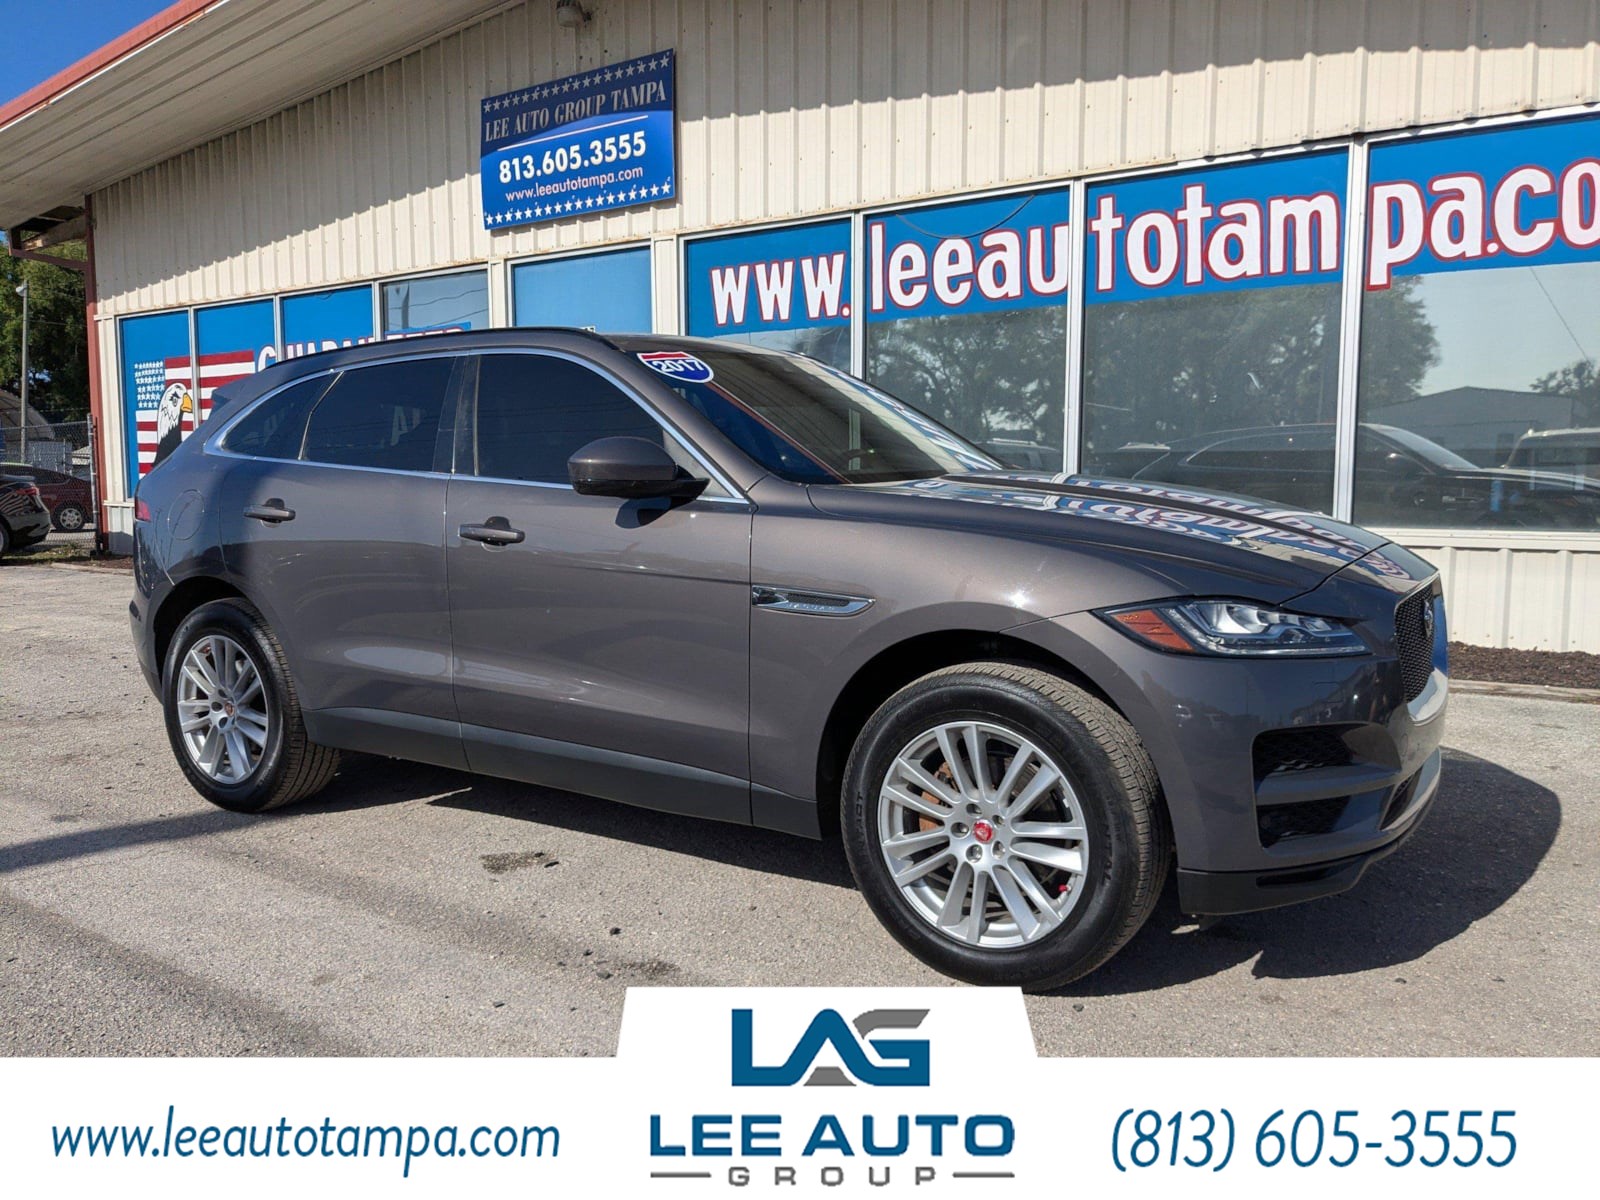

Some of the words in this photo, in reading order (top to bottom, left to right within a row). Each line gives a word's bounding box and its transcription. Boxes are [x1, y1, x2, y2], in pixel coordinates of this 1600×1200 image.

[485, 117, 510, 142] LEE
[513, 108, 550, 134] AUTO
[554, 94, 606, 125] GROUP
[611, 79, 666, 111] TAMPA
[499, 130, 647, 184] 813.605.3555
[505, 166, 643, 202] www.leeautotampa.com
[651, 359, 704, 373] 2017
